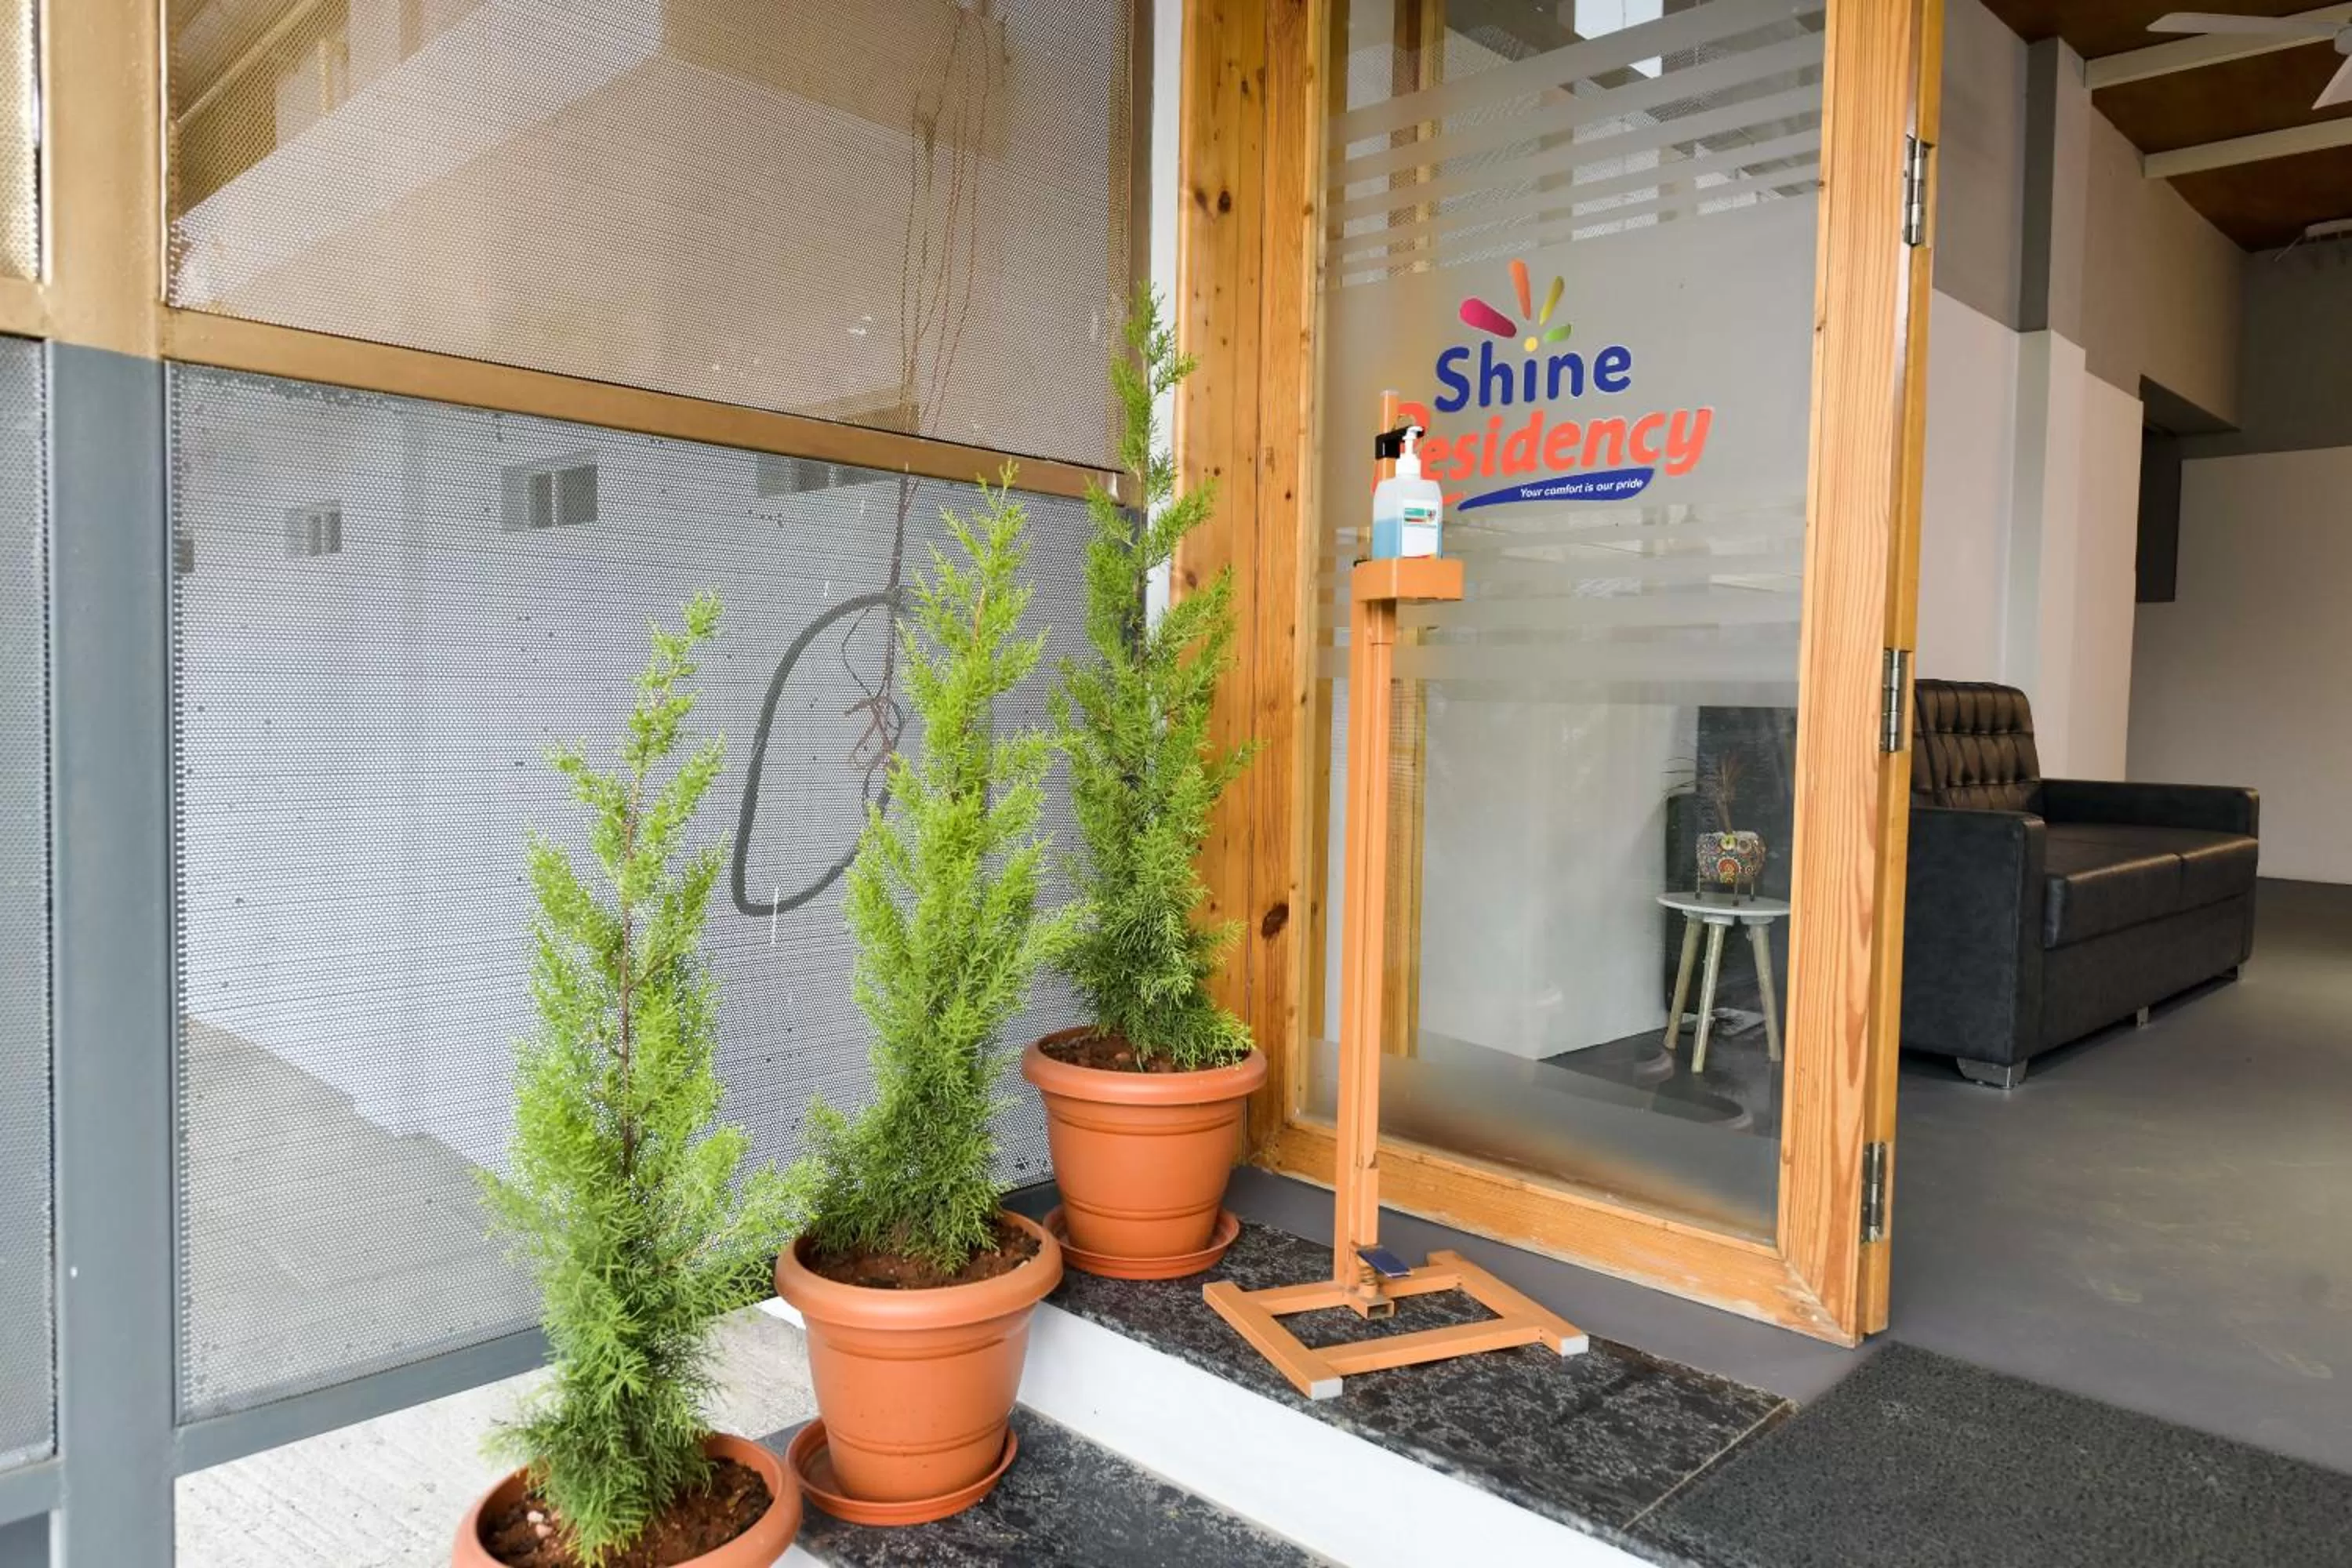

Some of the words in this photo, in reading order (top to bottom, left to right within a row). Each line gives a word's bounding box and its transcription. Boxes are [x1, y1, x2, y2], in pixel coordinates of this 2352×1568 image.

[1435, 337, 1632, 412] Shine
[1520, 488, 1543, 498] Your
[1544, 484, 1583, 495] comfort
[1584, 482, 1594, 493] is
[1596, 481, 1615, 492] our
[1616, 477, 1644, 492] pride
